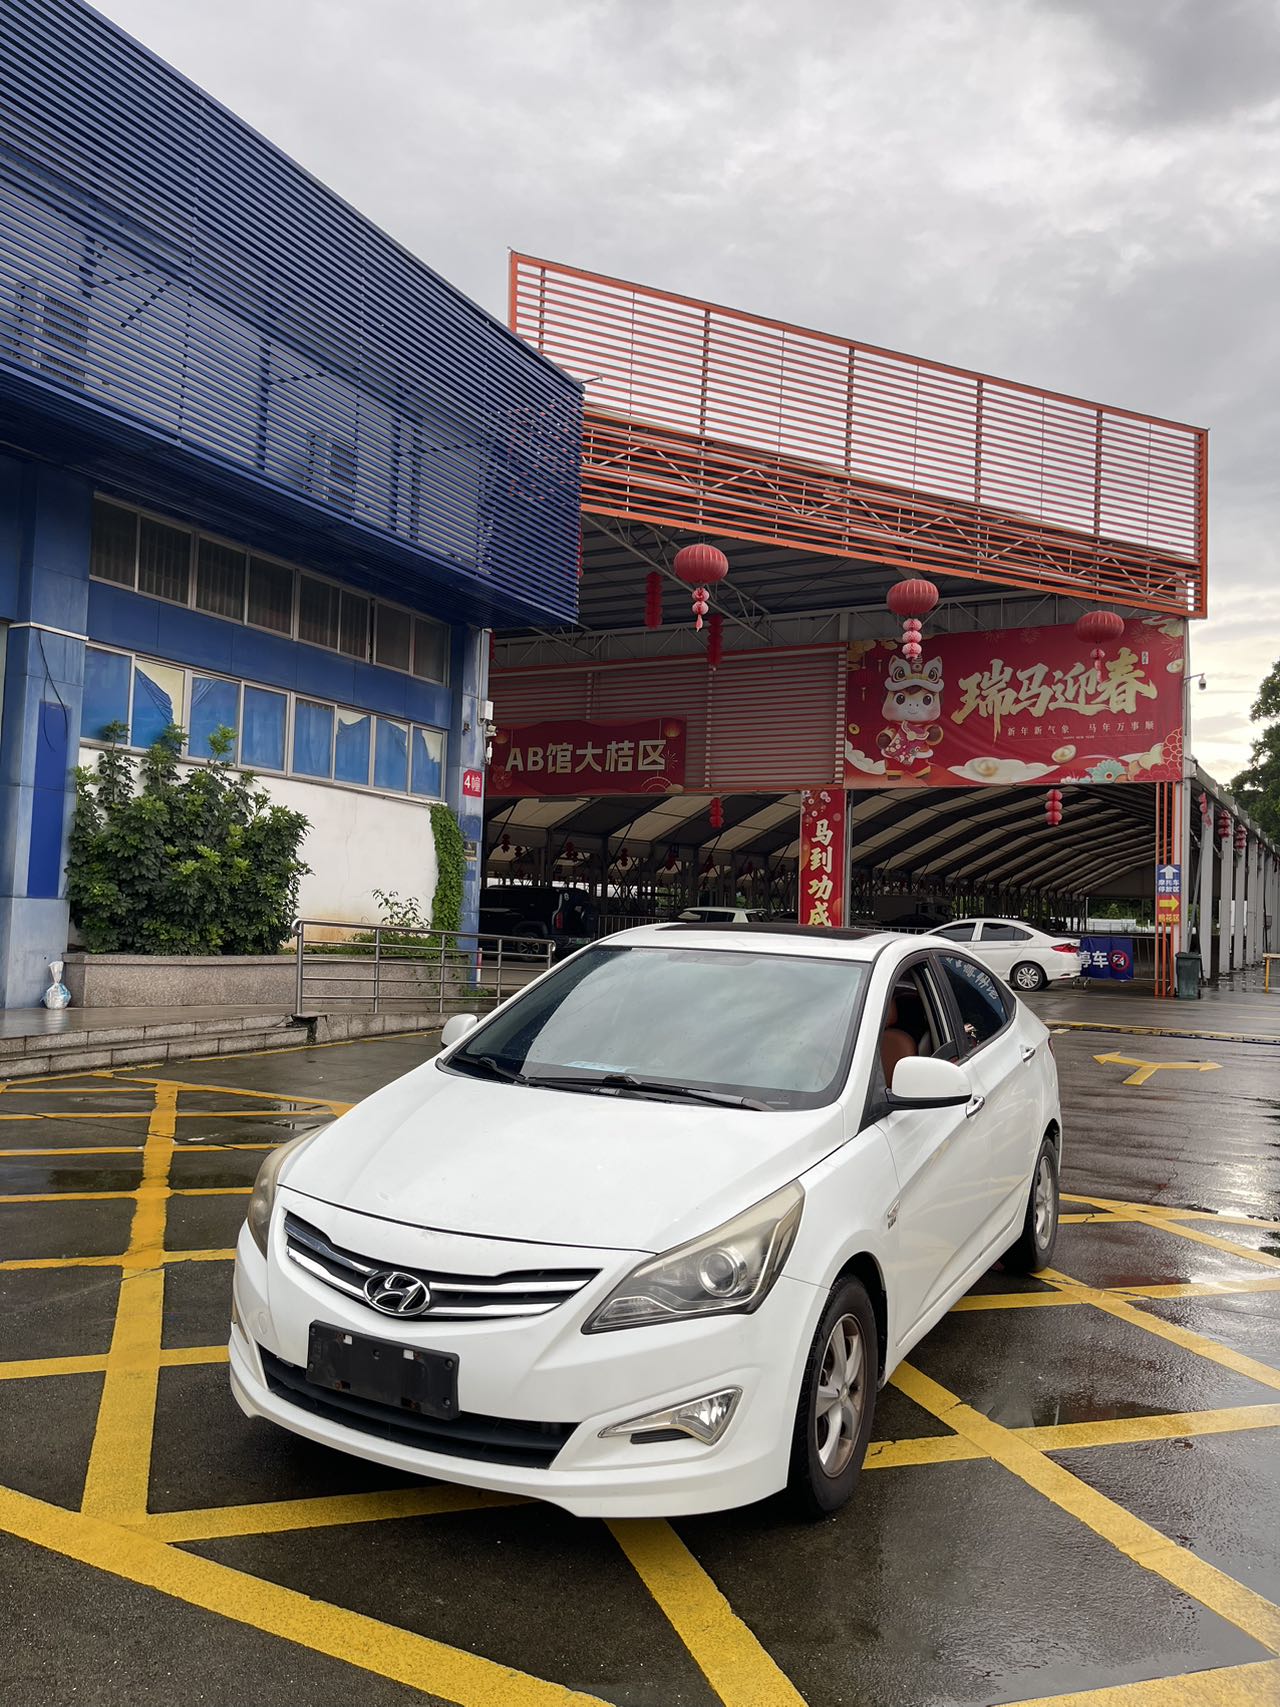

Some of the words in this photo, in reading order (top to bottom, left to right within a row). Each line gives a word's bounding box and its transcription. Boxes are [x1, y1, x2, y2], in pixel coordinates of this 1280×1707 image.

[951, 647, 1158, 744] 瑞马迎春
[1007, 723, 1070, 737] 新年新气象
[1088, 720, 1155, 733] 马年万事顺
[504, 739, 667, 774] AB馆大桔区
[464, 774, 481, 793] 4幢
[807, 818, 834, 927] 马到功成
